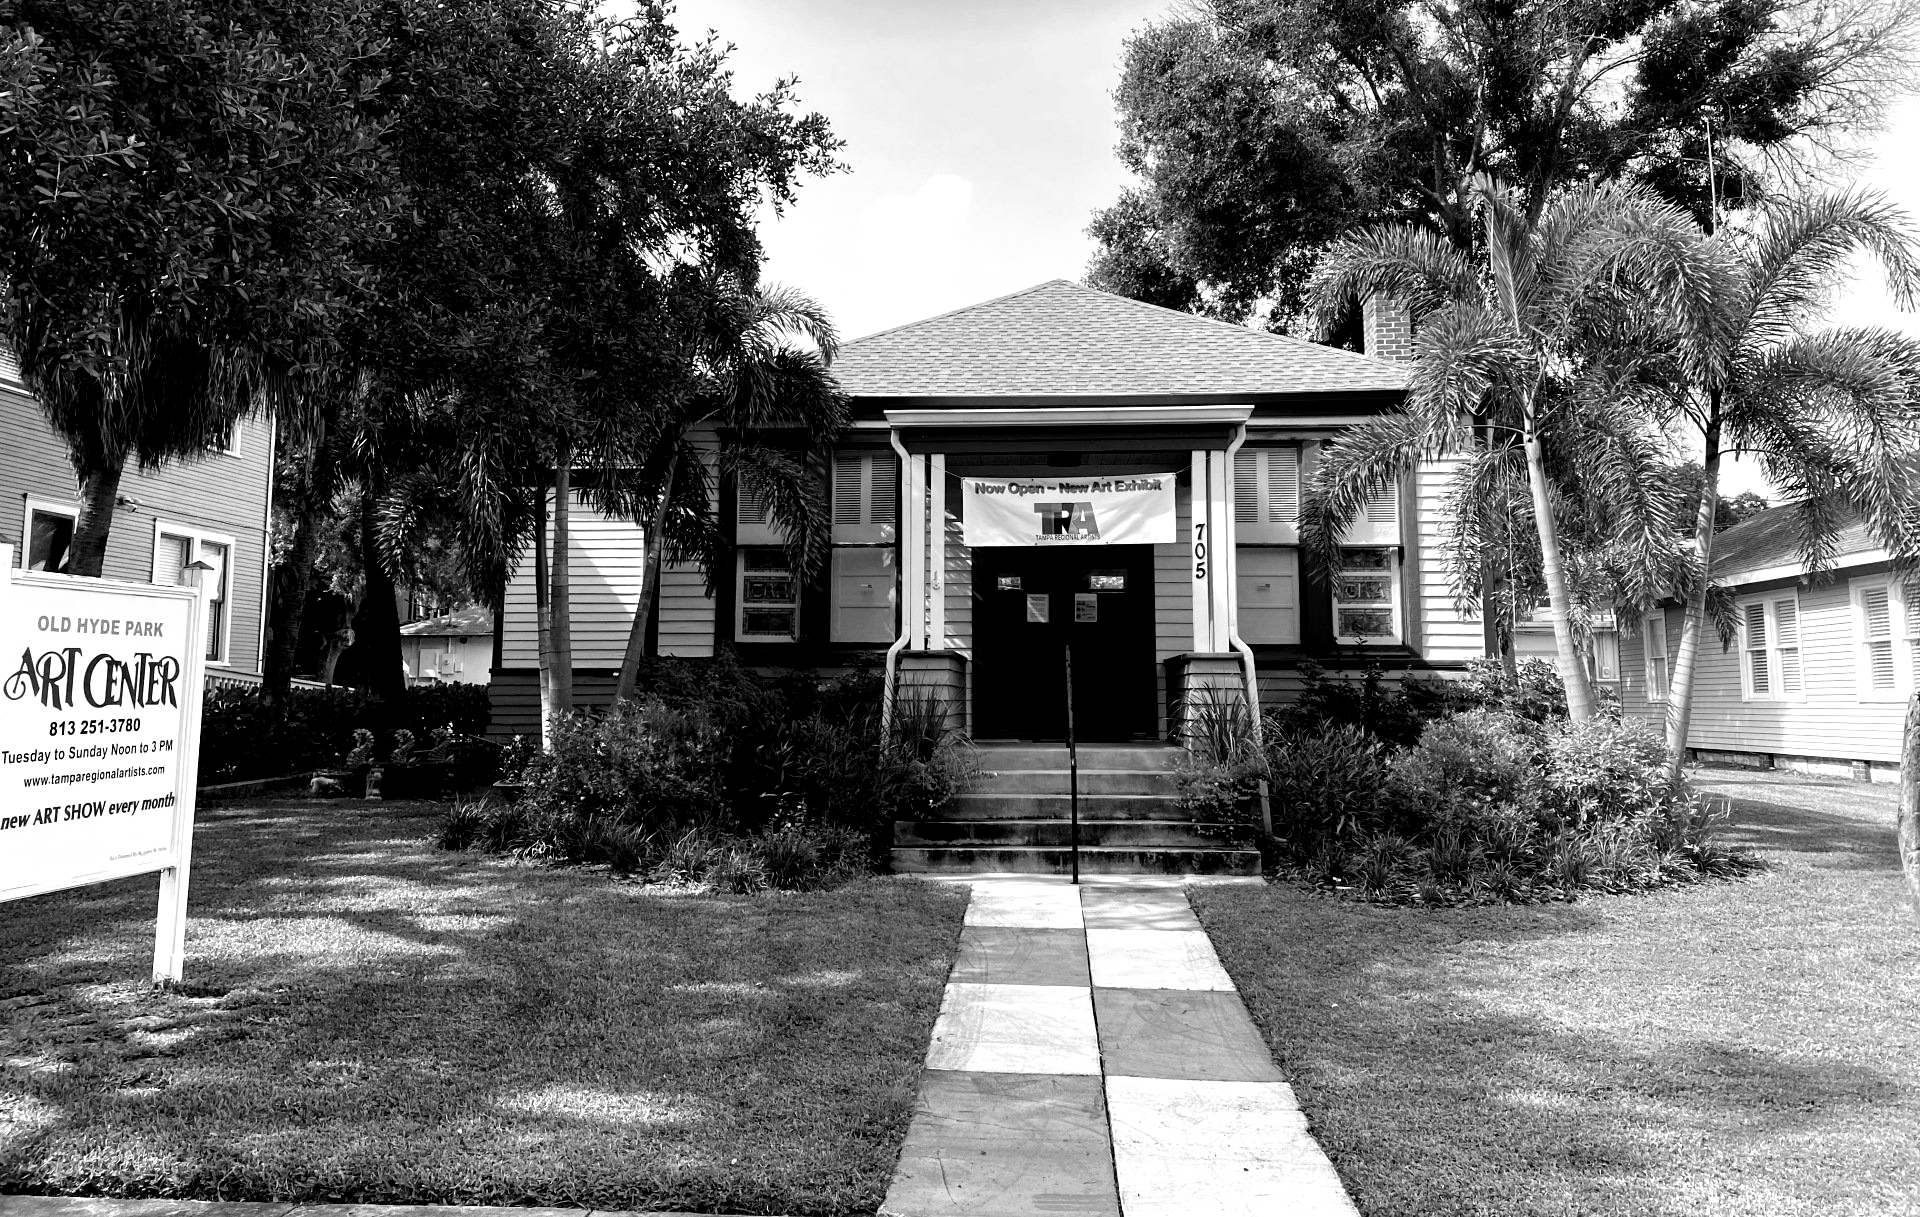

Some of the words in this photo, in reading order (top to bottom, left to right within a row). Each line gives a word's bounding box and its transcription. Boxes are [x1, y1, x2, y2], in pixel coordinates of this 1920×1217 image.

[974, 482, 1006, 495] Now
[1007, 482, 1045, 497] Open
[1058, 482, 1089, 494] New
[1090, 481, 1113, 493] Art
[1114, 479, 1163, 492] Exhibit
[1034, 502, 1100, 534] TRA
[1194, 523, 1206, 580] 705
[37, 615, 72, 633] OLD
[77, 618, 121, 635] HYDE
[125, 620, 164, 637] PARK
[3, 646, 83, 711] ART
[83, 652, 180, 710] CENTER
[49, 721, 76, 737] 813
[80, 718, 141, 735] 251-3780
[2, 749, 51, 765] Tuesday
[54, 748, 65, 761] to
[68, 744, 109, 760] Sunday
[111, 743, 137, 756] Noon
[139, 742, 149, 754] to
[151, 740, 157, 752] 3
[159, 739, 173, 752] PM
[23, 766, 165, 788] www.tamparegionalartists.com
[0, 814, 31, 831] new
[32, 806, 62, 826] ART
[63, 800, 107, 822] SHOW
[108, 800, 140, 816] every
[141, 791, 176, 811] month
